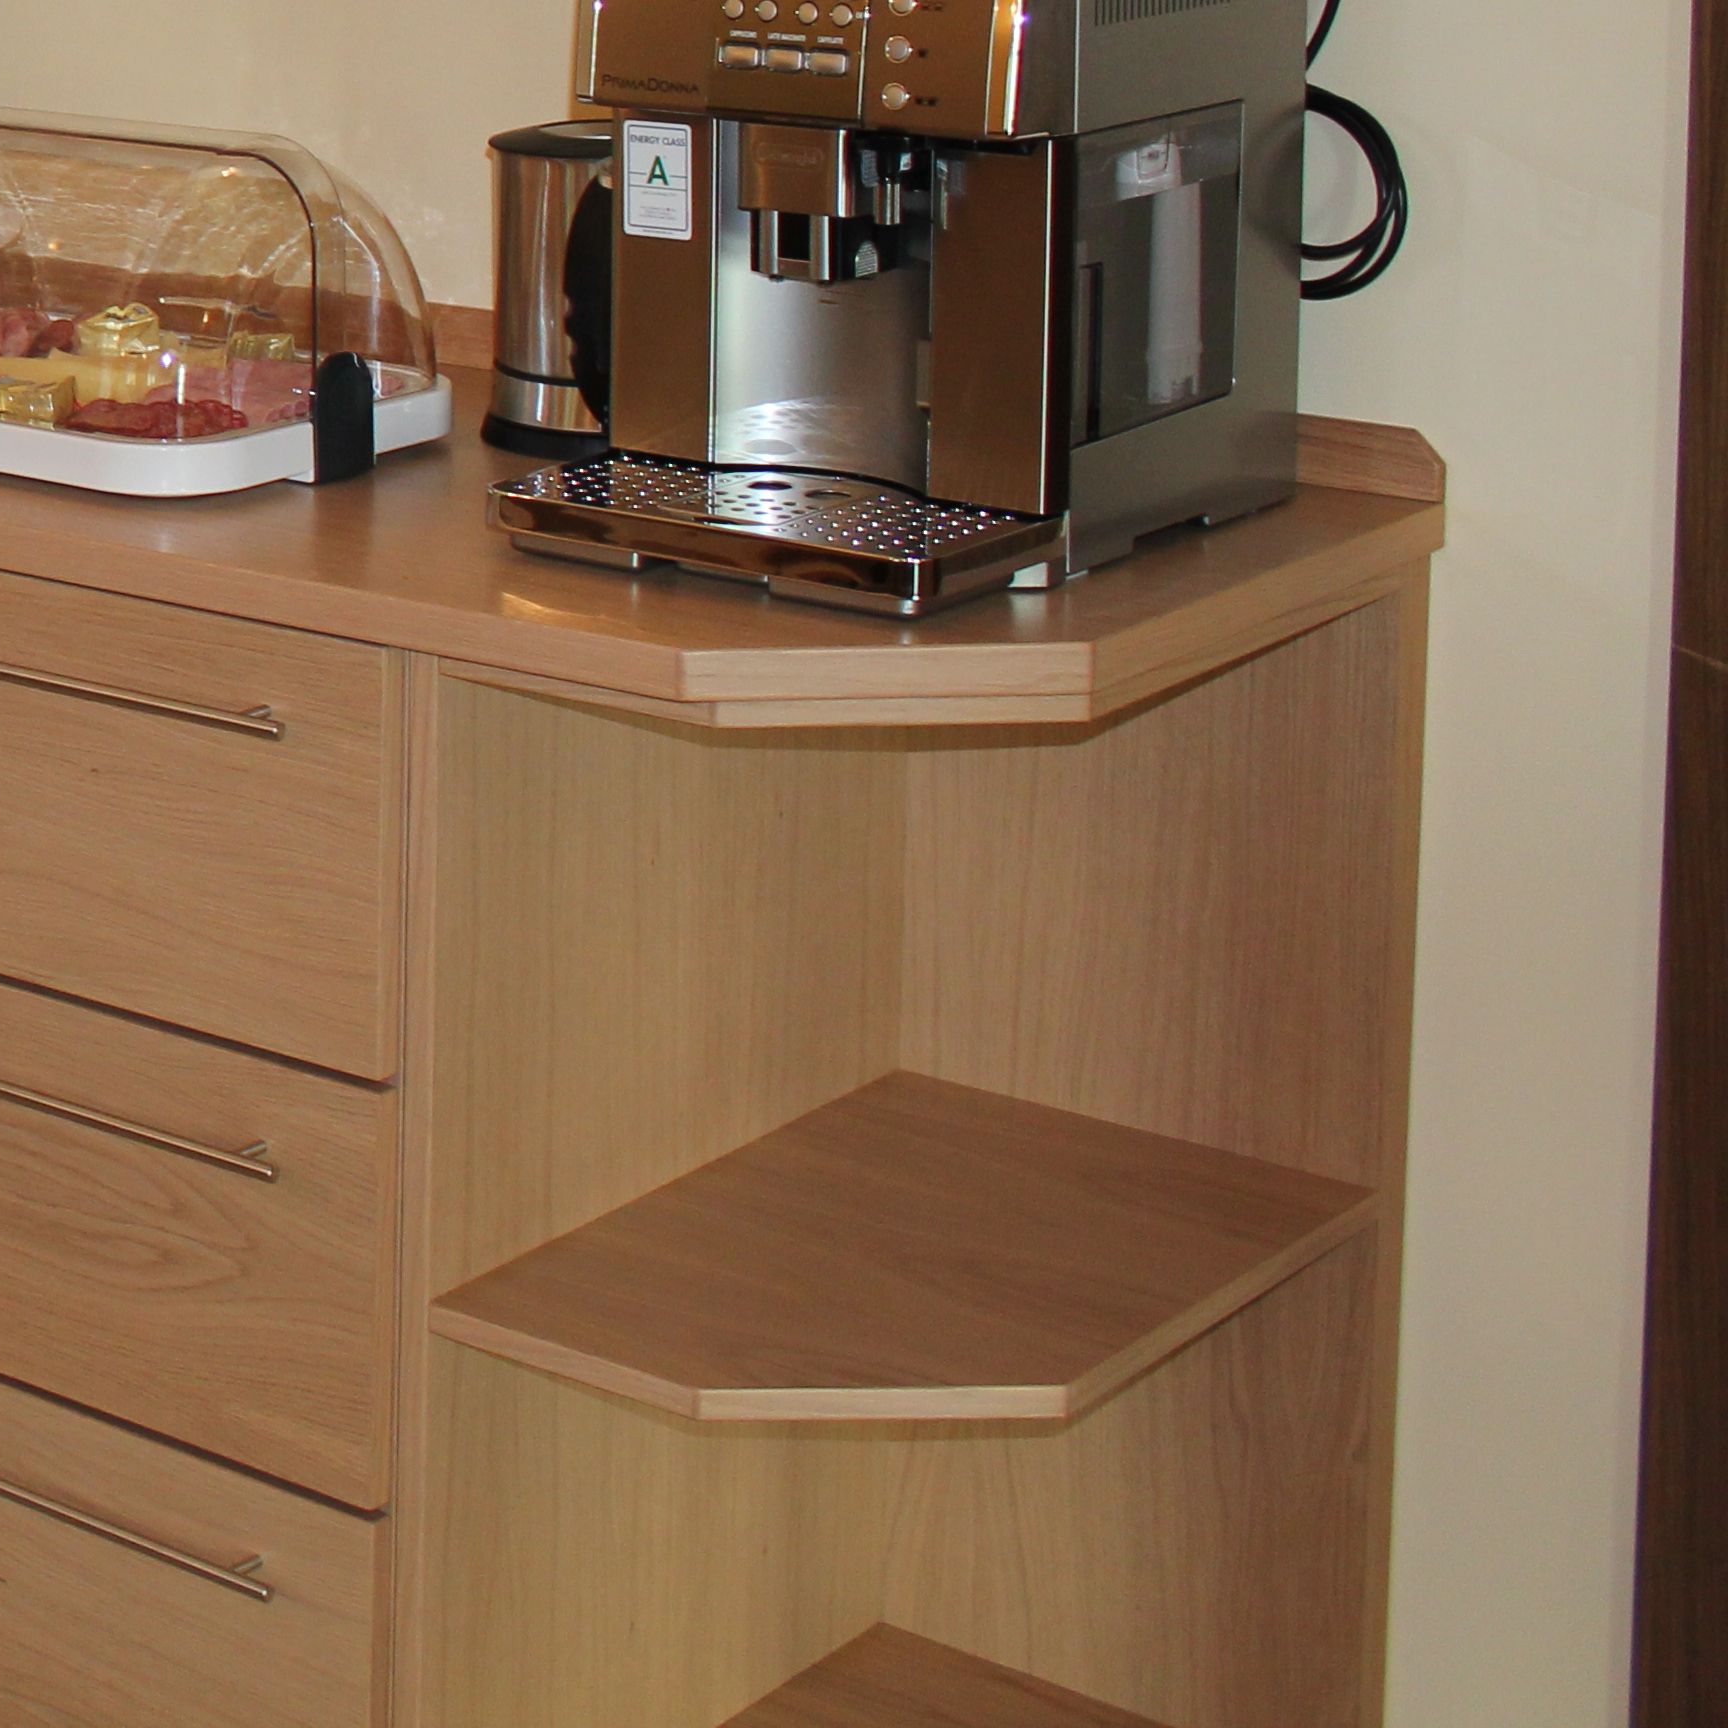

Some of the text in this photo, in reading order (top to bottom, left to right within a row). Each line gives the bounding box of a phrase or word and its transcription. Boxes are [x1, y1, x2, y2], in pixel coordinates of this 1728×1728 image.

[630, 134, 687, 147] ENERGY CLASS
[646, 155, 670, 186] A
